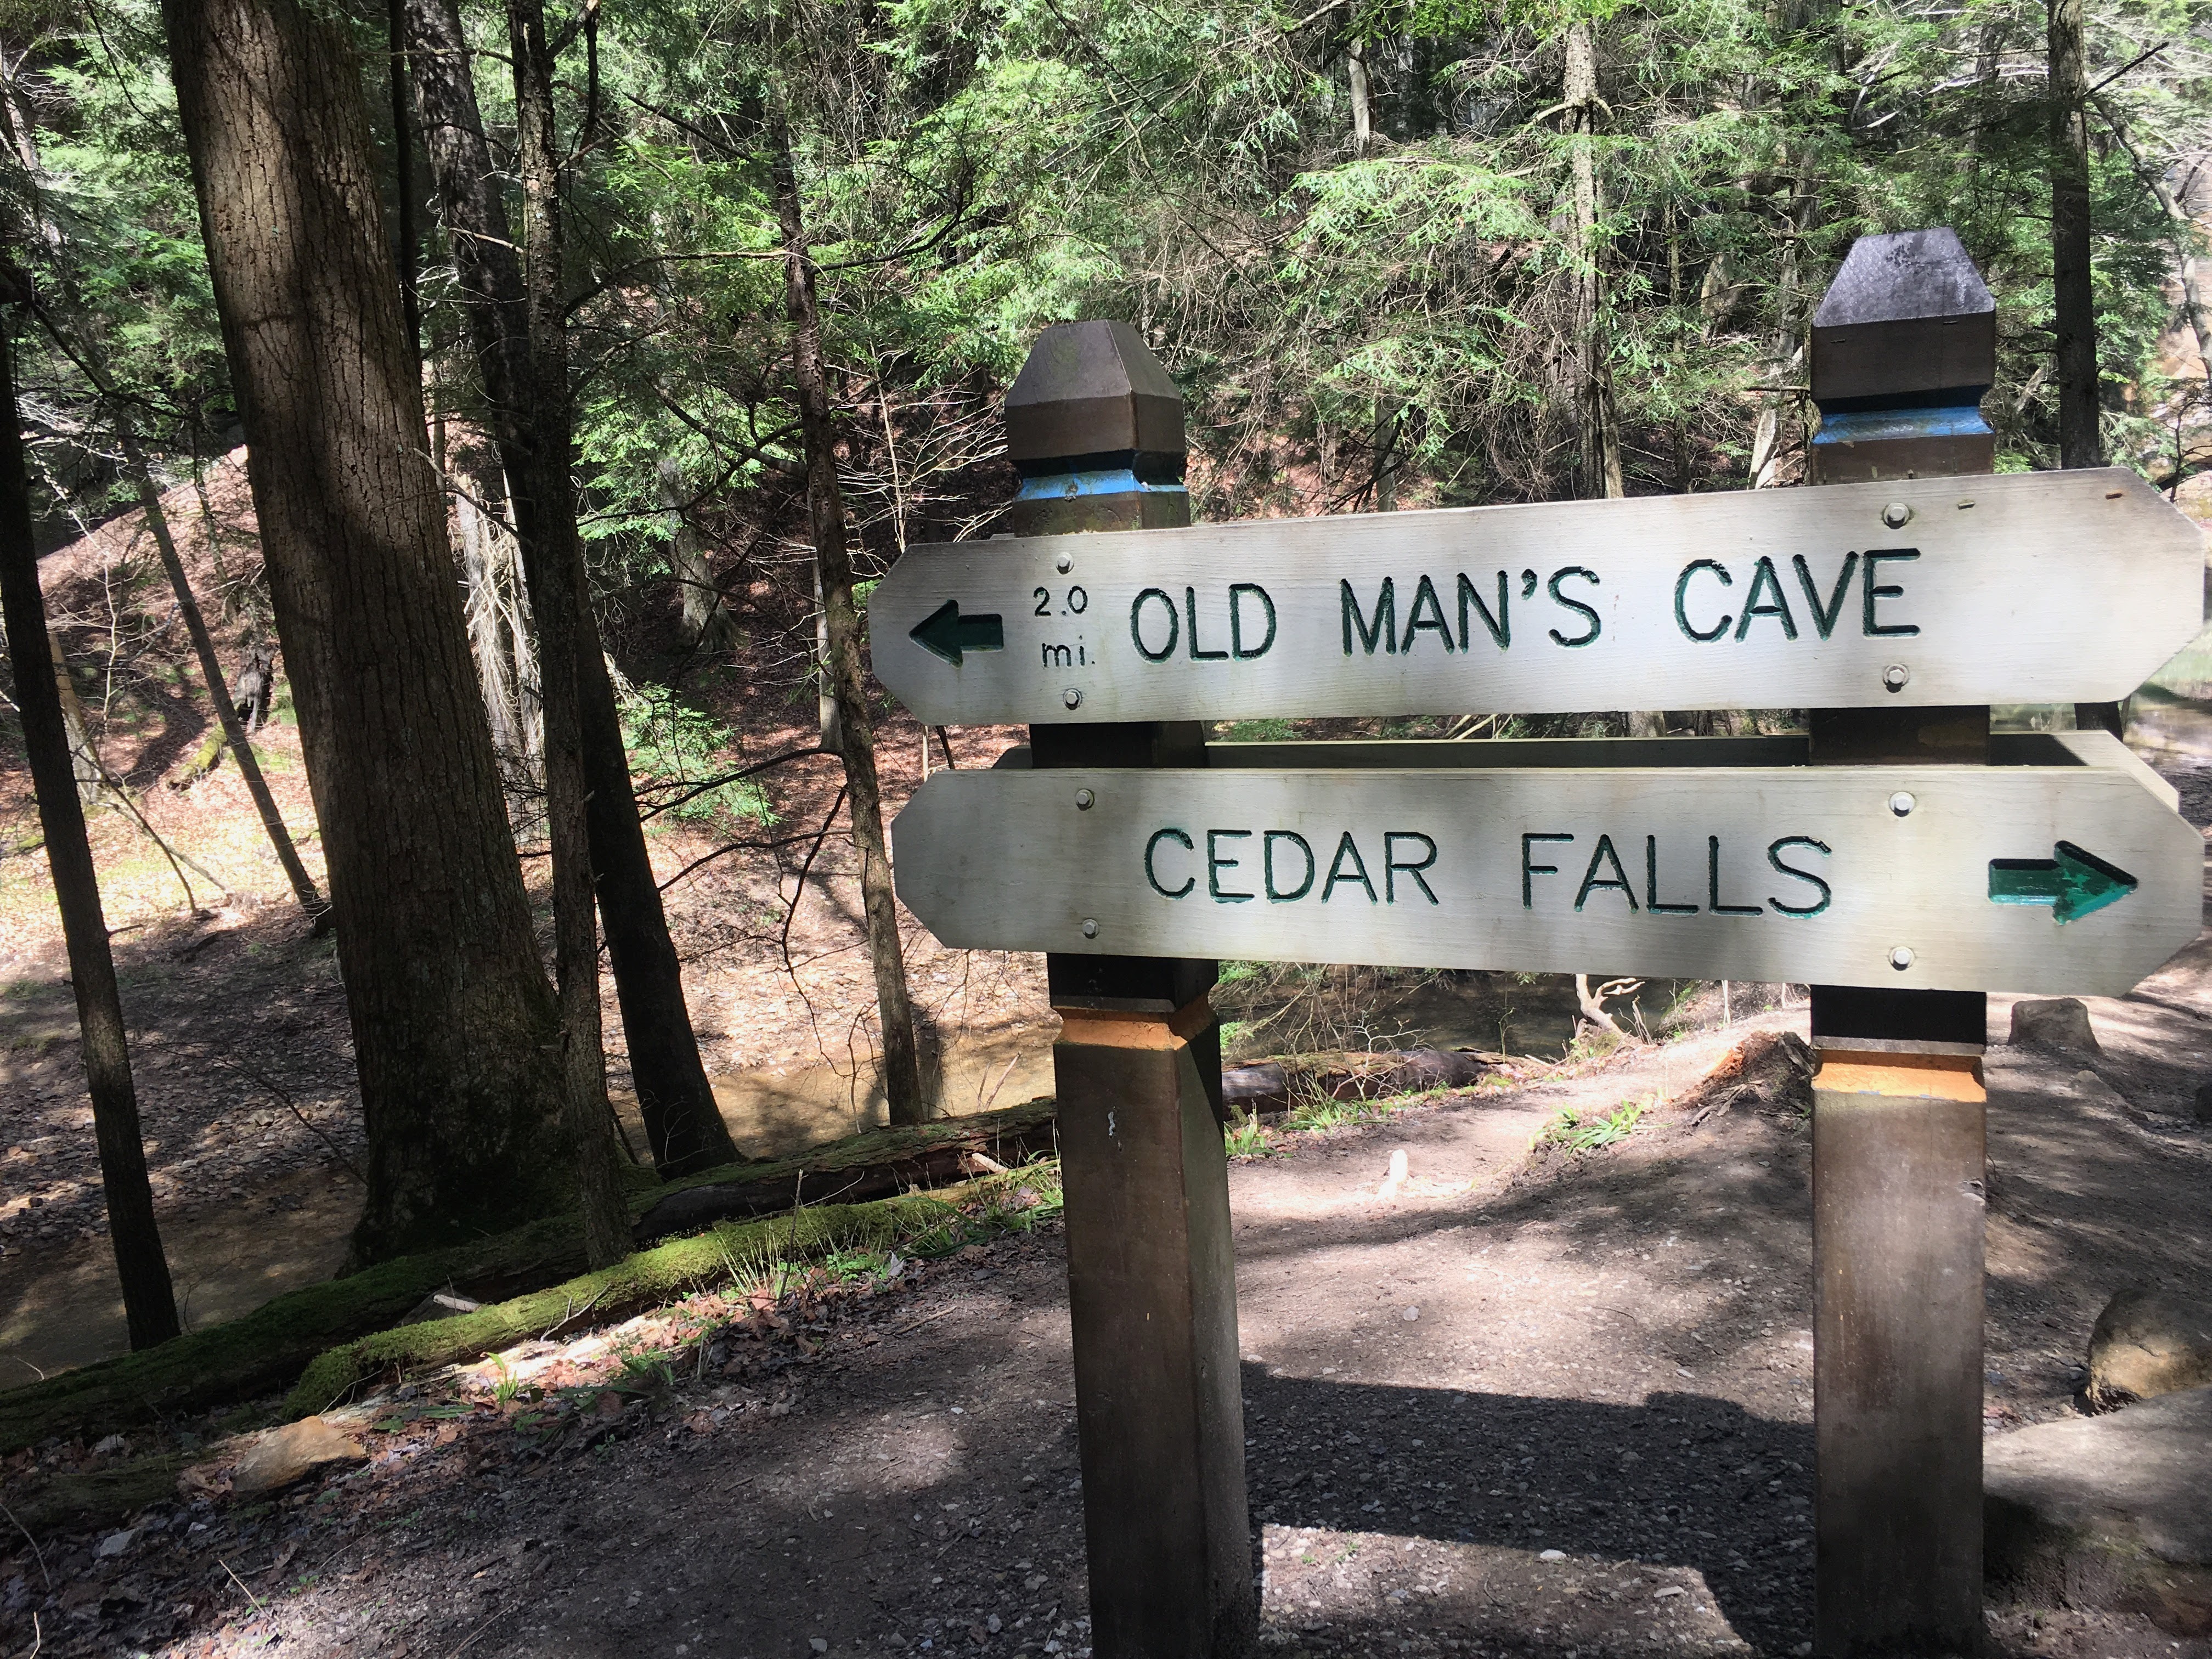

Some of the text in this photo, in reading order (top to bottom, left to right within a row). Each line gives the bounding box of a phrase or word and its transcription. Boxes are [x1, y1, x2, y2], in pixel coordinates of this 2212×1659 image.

[1032, 585, 1088, 617] 2.0
[1130, 547, 1921, 664] OLD MAN'S CAVE
[1041, 635, 1096, 669] mi.
[1144, 827, 1832, 919] CEDAR FALLS
